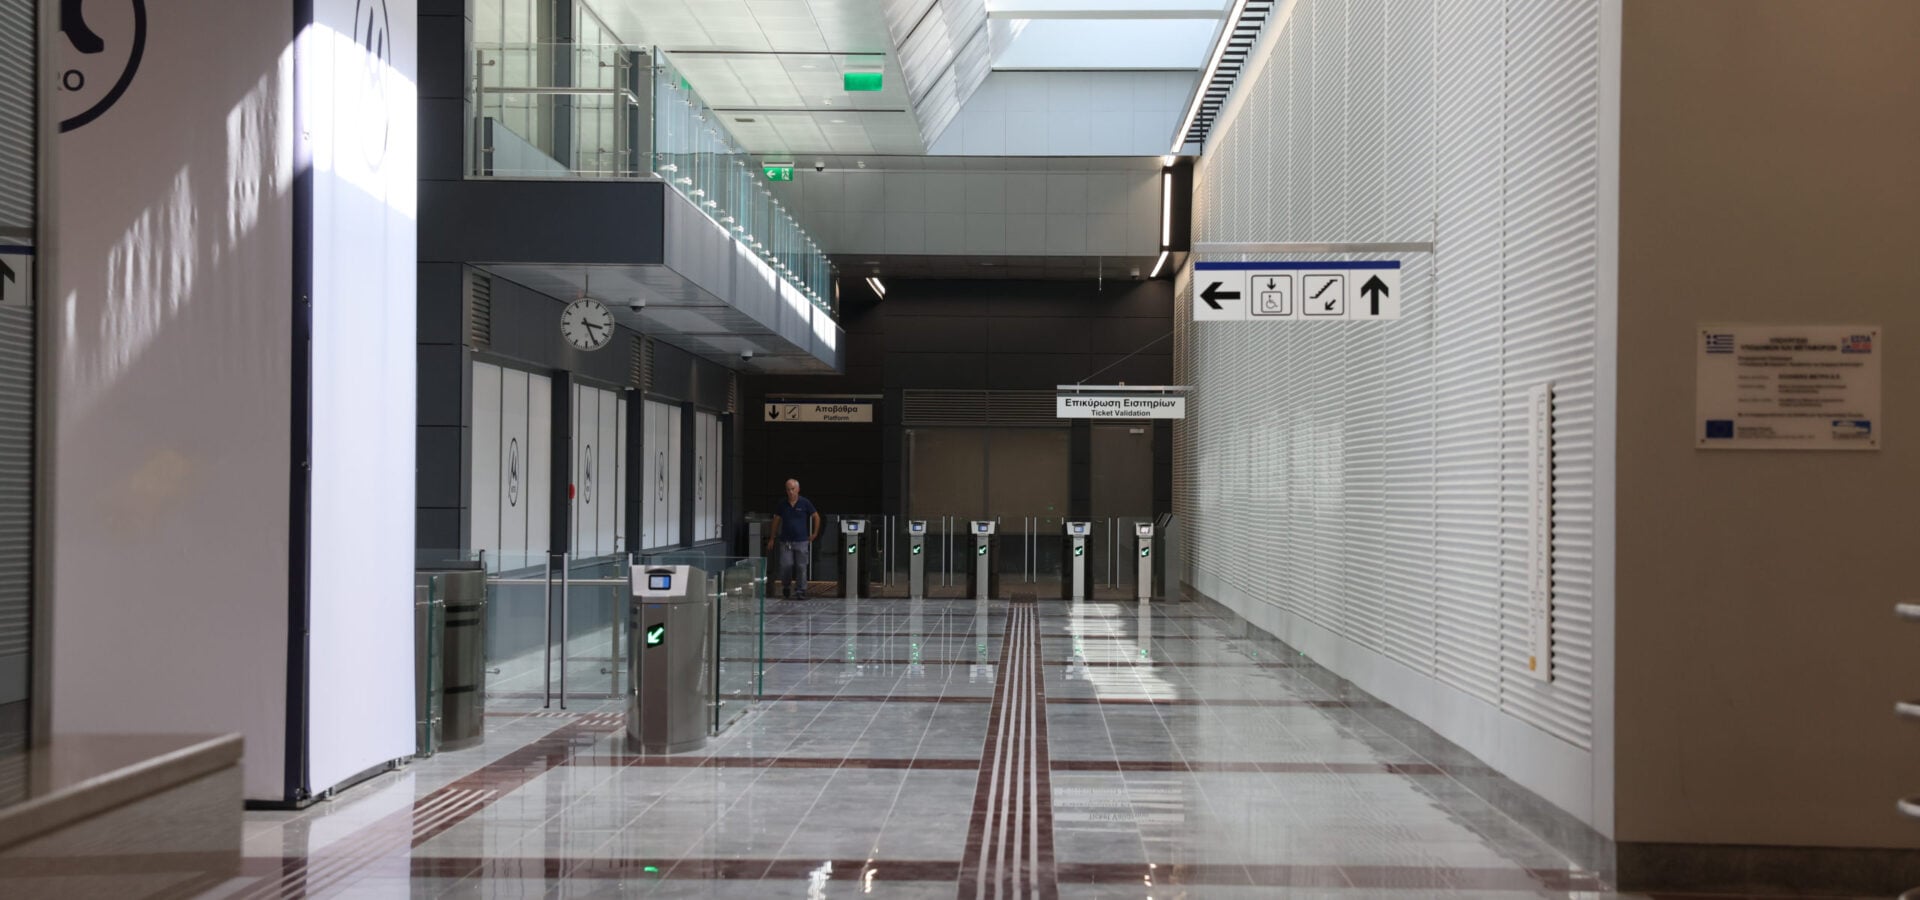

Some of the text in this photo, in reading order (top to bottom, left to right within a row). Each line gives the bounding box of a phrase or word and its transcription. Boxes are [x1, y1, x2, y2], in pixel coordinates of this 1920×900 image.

[1065, 398, 1176, 408] Επικύρωση Εισιτηρίων
[815, 405, 858, 413] Αποβάθρα
